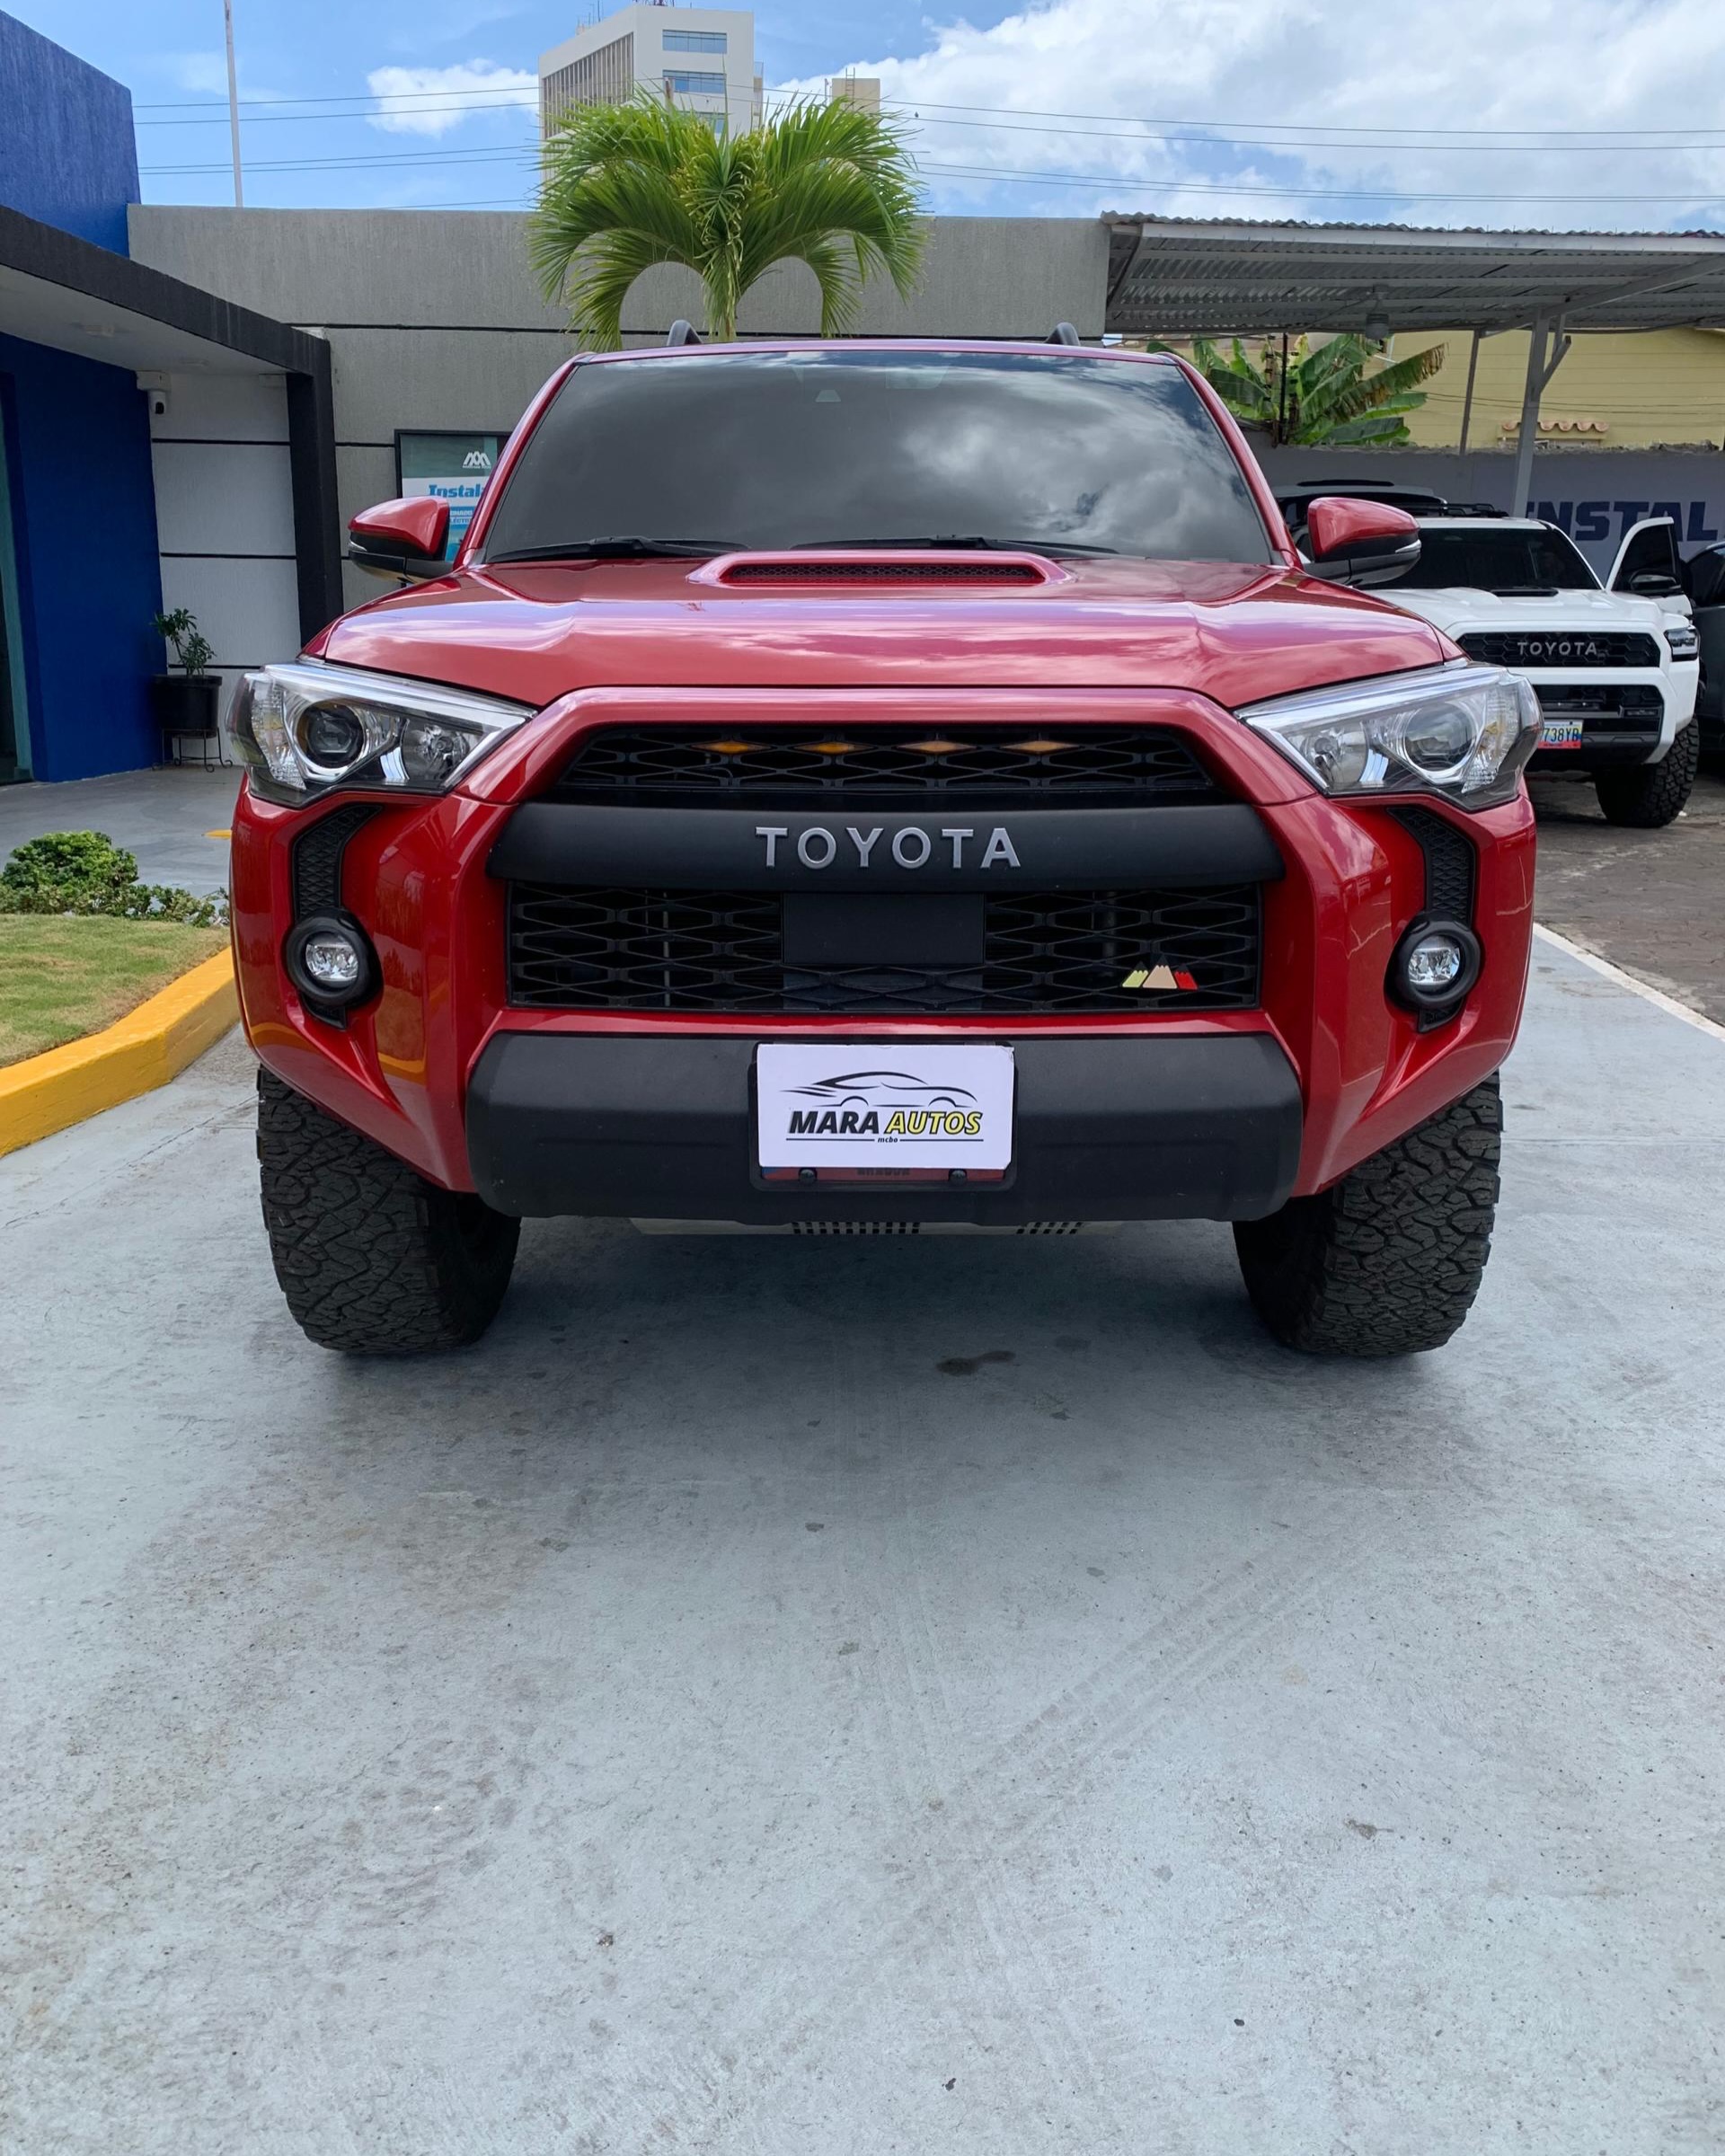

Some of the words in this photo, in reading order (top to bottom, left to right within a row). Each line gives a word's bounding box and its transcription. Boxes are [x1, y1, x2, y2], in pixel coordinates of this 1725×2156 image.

[1517, 641, 1597, 656] TOYOTA
[756, 826, 1021, 870] TOYOTA
[787, 1110, 880, 1135] MARA
[883, 1110, 983, 1135] AUTOS
[877, 1135, 899, 1144] mcbo
